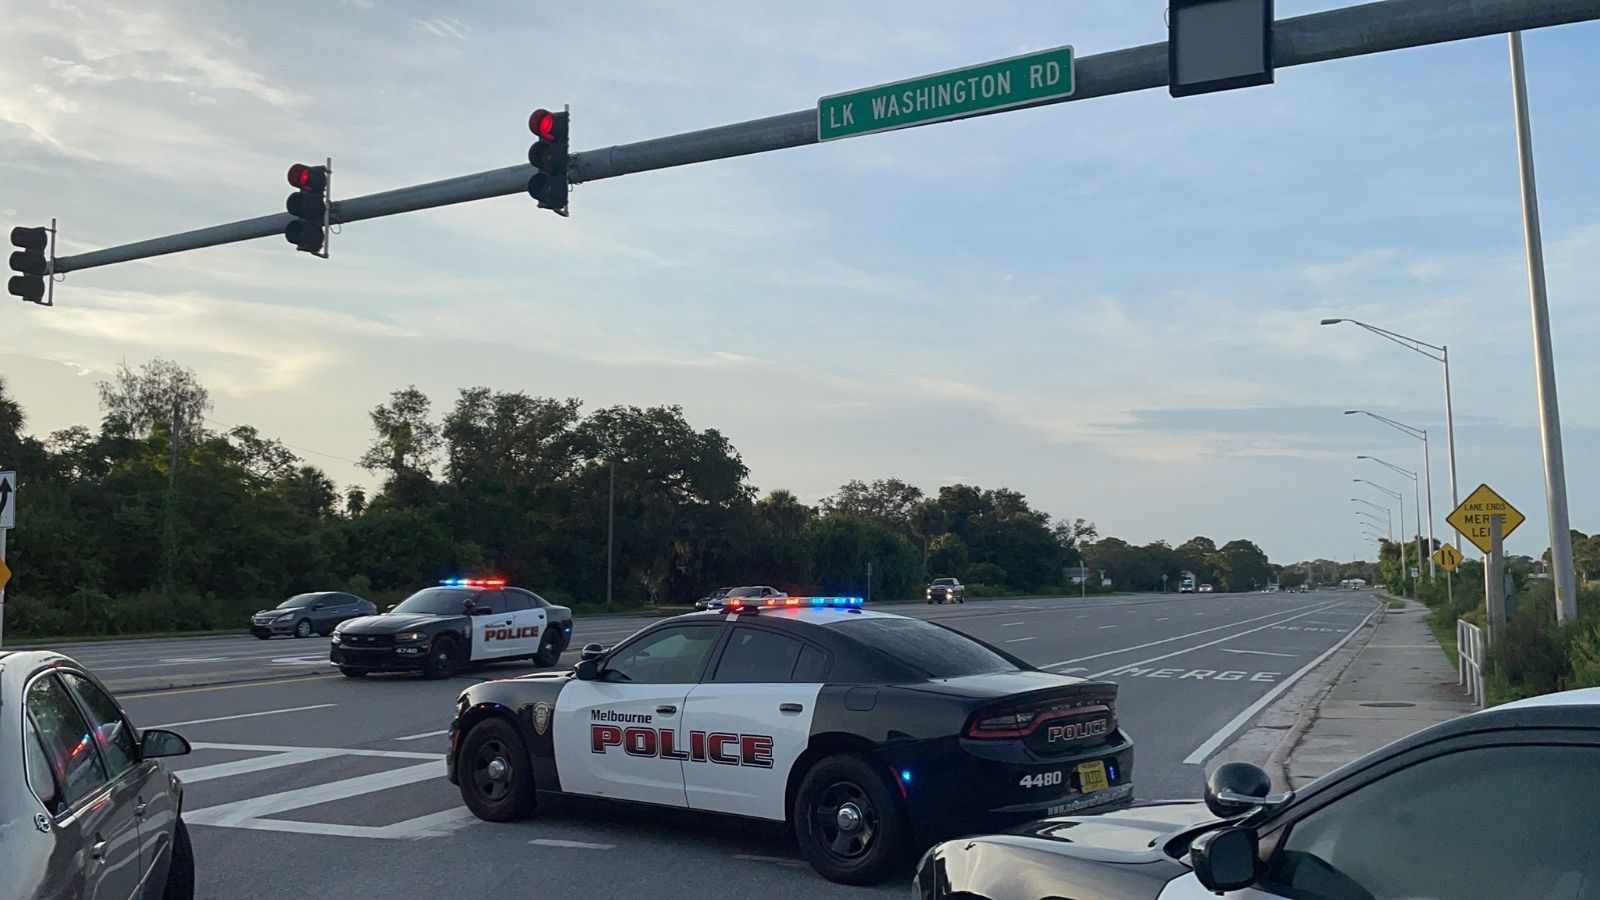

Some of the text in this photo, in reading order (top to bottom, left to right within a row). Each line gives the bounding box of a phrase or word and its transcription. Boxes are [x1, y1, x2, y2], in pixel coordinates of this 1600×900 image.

[830, 61, 1060, 128] LK WASHINGTON RD
[1464, 503, 1506, 511] LANE ENDS
[1464, 514, 1506, 524] MERE
[1472, 527, 1490, 537] LE
[484, 626, 539, 642] POLICE
[1111, 667, 1281, 682] MERGE
[591, 709, 652, 724] Melbourne
[1048, 719, 1107, 742] POLICE
[590, 723, 774, 769] POLICE
[1019, 770, 1062, 788] 4480
